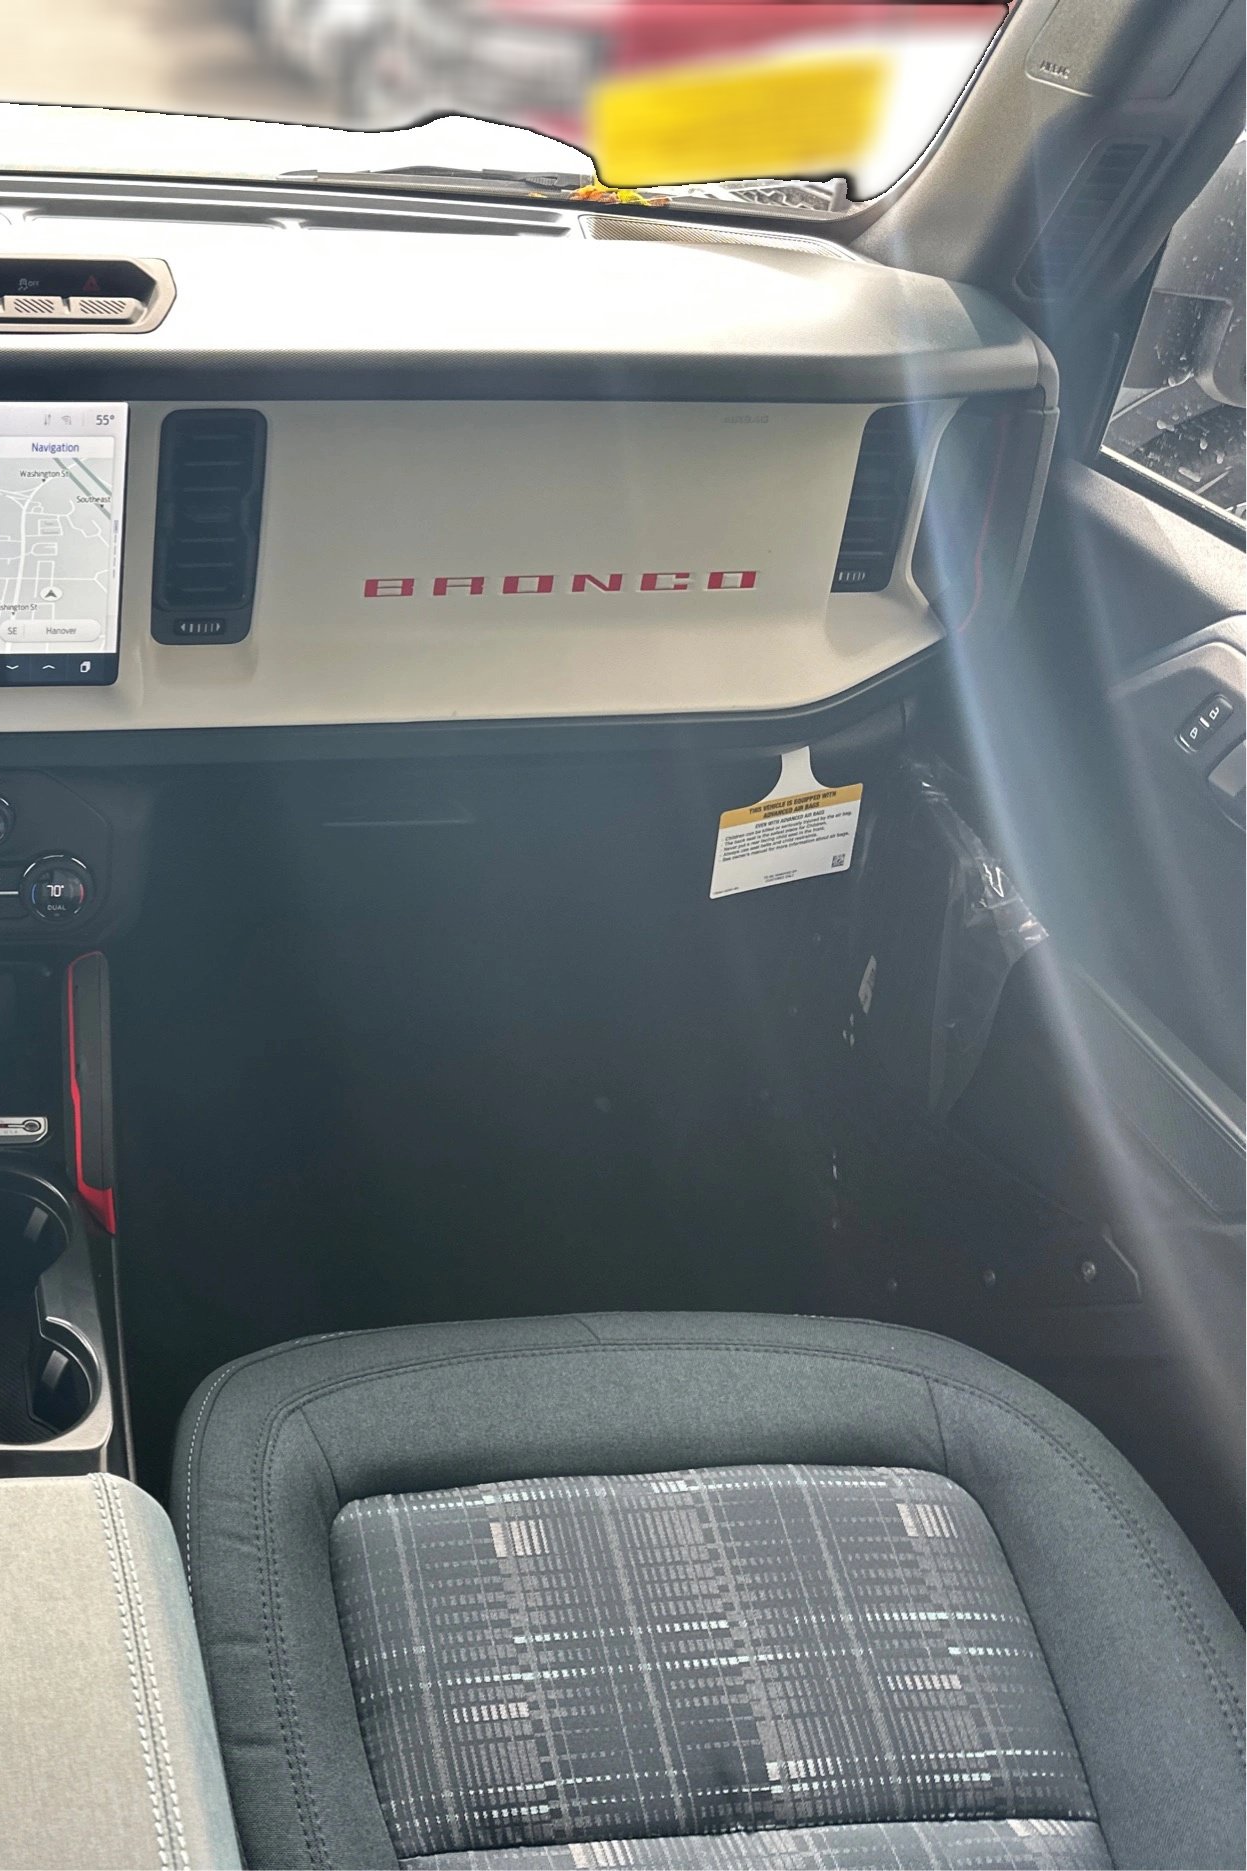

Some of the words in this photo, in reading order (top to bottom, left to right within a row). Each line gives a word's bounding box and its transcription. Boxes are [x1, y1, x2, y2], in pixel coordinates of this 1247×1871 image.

[31, 443, 79, 454] Navigation
[20, 470, 56, 479] Washington
[364, 571, 757, 597] BRONCO
[7, 627, 17, 635] SE
[46, 627, 77, 635] Hanover
